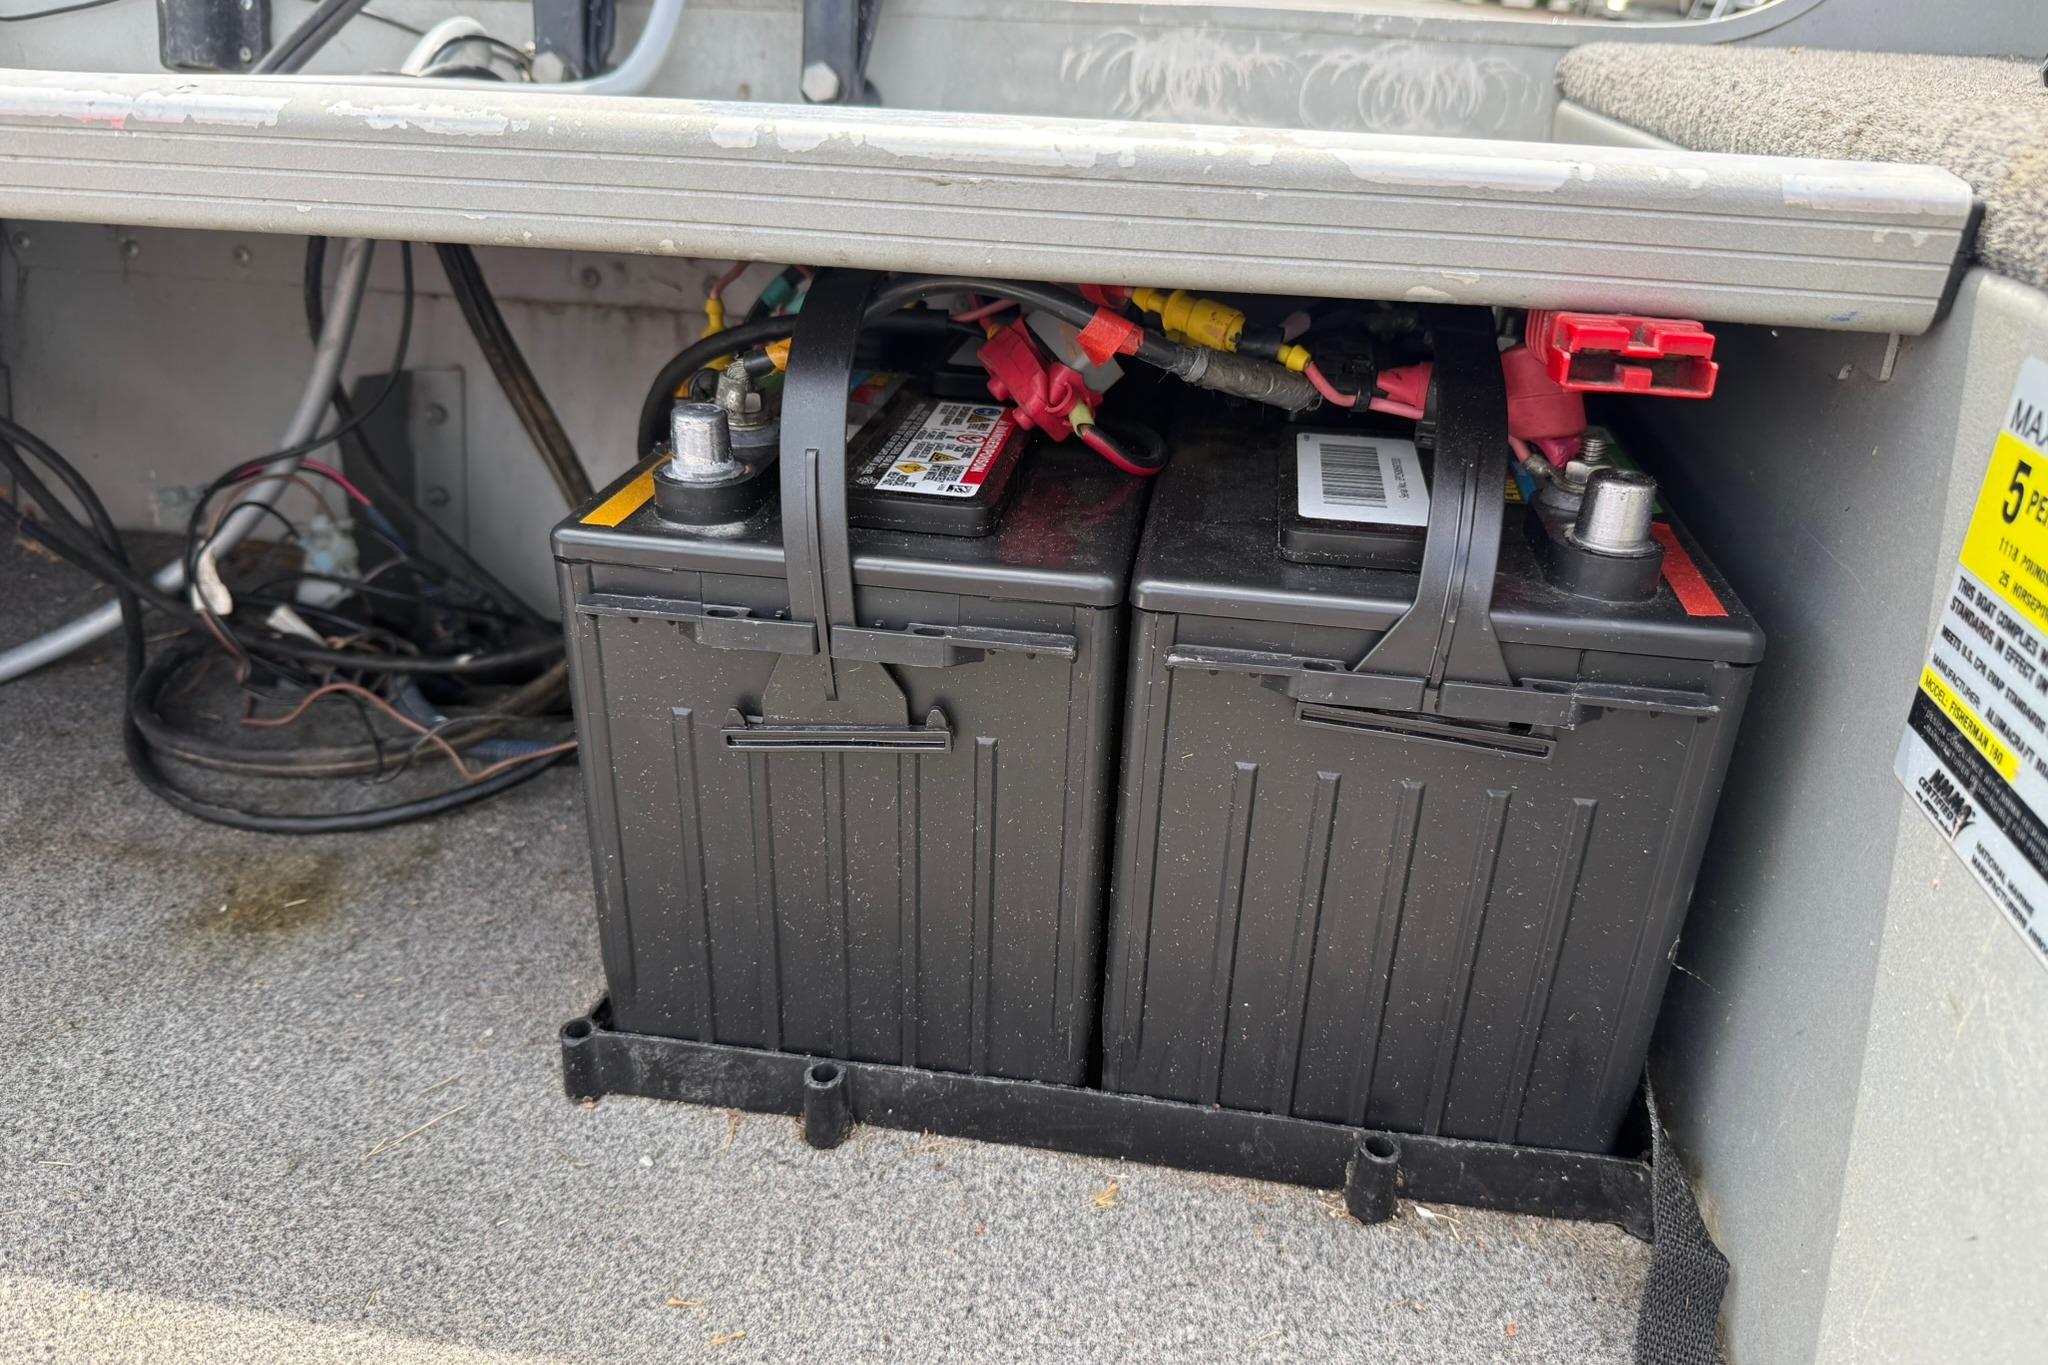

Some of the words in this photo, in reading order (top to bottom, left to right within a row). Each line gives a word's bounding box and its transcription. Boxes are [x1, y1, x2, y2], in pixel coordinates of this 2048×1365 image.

[2002, 459, 2032, 524] 5
[1950, 595, 1995, 645] STANDARDS
[2004, 645, 2036, 682] EFFECT
[1958, 575, 1976, 602] THIS
[1975, 591, 1997, 619] BOAT
[1996, 610, 2038, 657] COMPLIES
[1941, 624, 1962, 651] MEETS
[1973, 656, 1987, 677] EPA
[2005, 686, 2046, 734] STANDARDS
[1948, 701, 1989, 750] FISHERMAN
[1984, 706, 2035, 764] ALUMACRAFT
[1918, 776, 1954, 820] CERTIFIED
